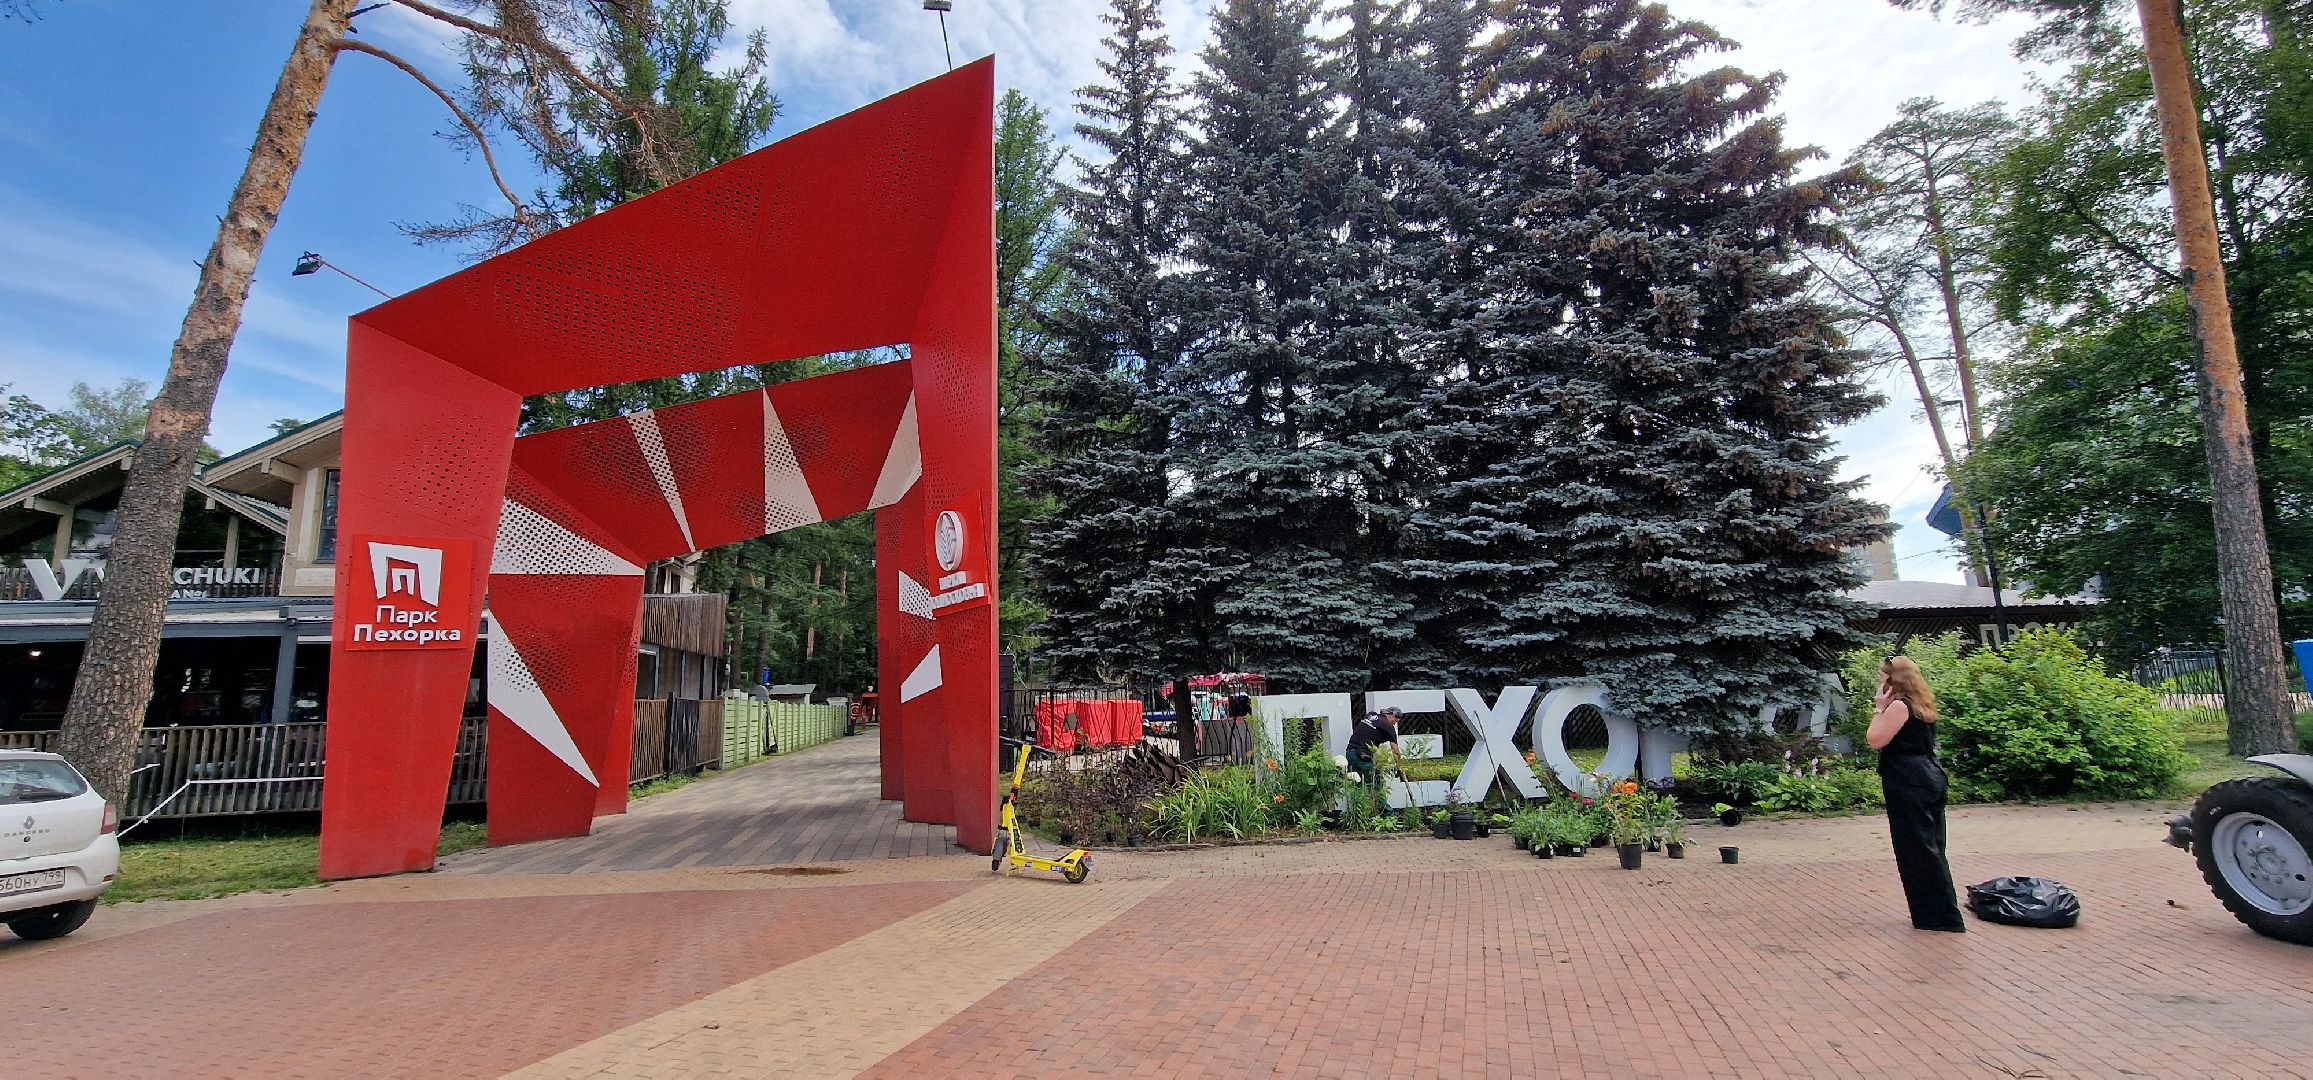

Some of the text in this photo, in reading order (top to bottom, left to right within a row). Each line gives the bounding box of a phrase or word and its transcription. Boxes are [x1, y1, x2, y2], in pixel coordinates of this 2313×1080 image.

[376, 604, 439, 628] Парк
[353, 623, 461, 646] Пехорка
[1252, 673, 1848, 811] ПЕХО
[43, 870, 61, 882] 799
